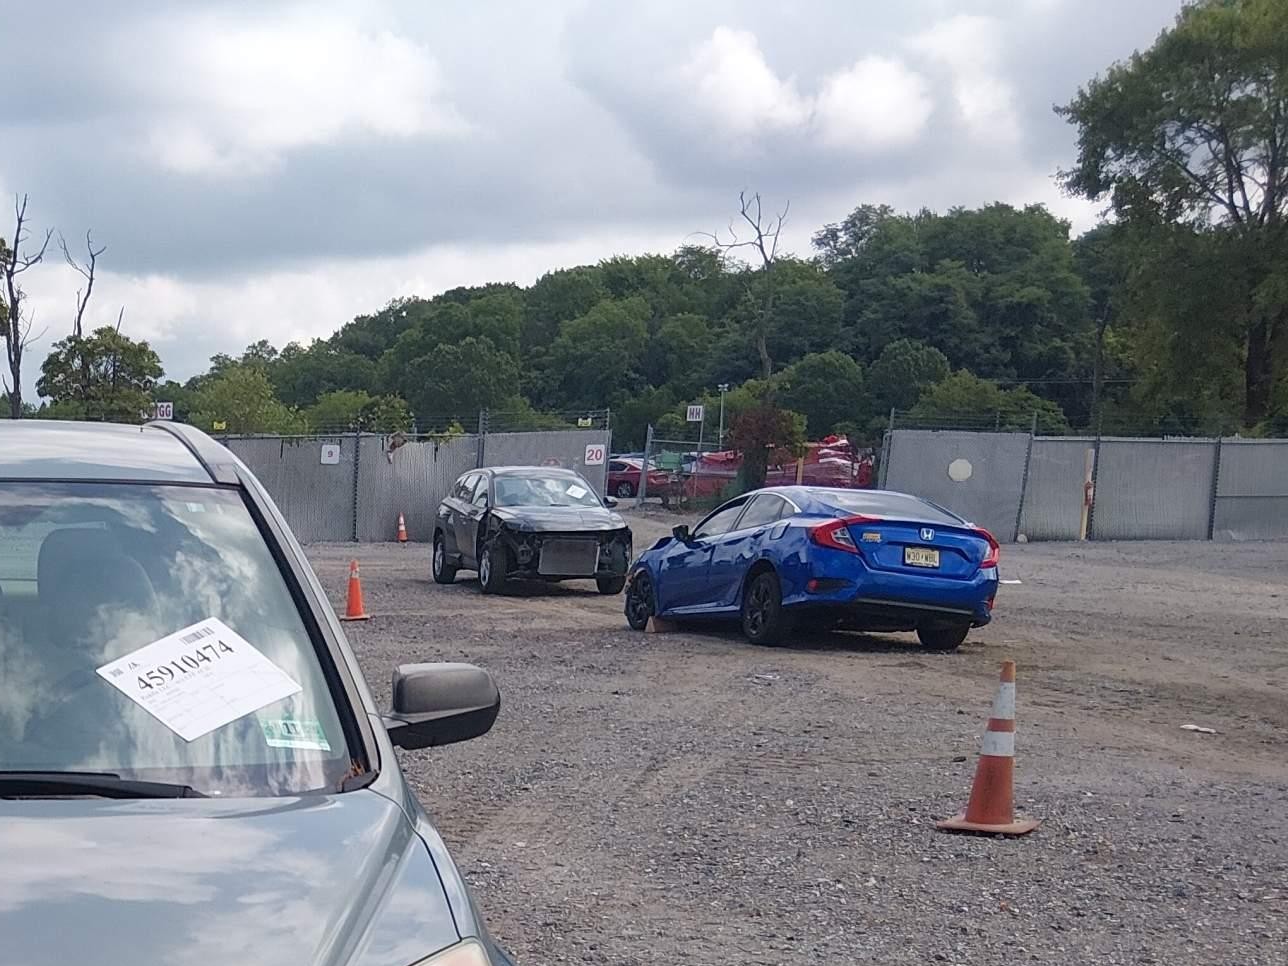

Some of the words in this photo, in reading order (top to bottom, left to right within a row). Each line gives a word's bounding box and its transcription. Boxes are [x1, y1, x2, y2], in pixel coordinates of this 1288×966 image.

[159, 404, 171, 417] GG
[689, 408, 701, 419] HH
[327, 450, 334, 458] 9
[587, 448, 602, 461] 20
[137, 639, 235, 691] 45910474
